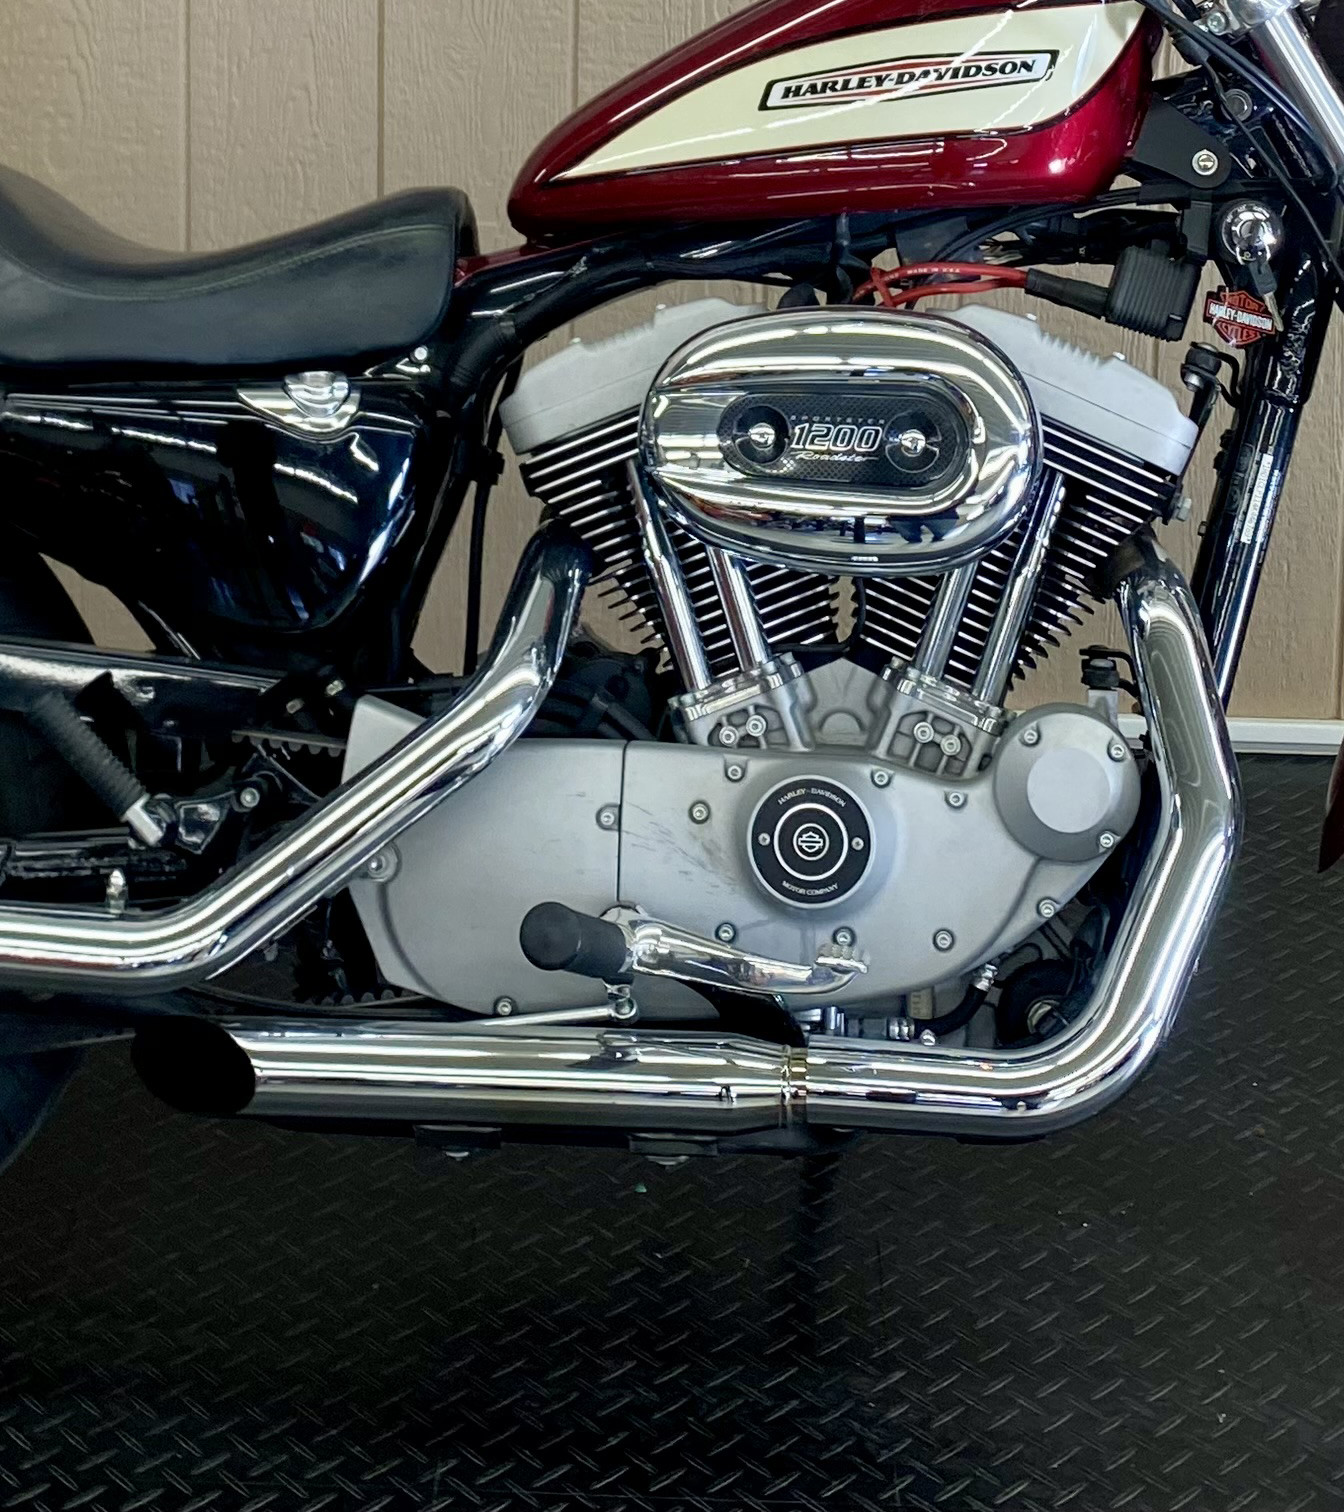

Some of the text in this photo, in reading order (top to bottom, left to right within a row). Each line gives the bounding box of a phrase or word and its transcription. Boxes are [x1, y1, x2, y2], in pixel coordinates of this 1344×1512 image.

[780, 59, 1037, 100] HARLEY-DAVIDSON
[790, 422, 883, 452] 1200
[782, 880, 839, 896] MOTOR COMPANY
